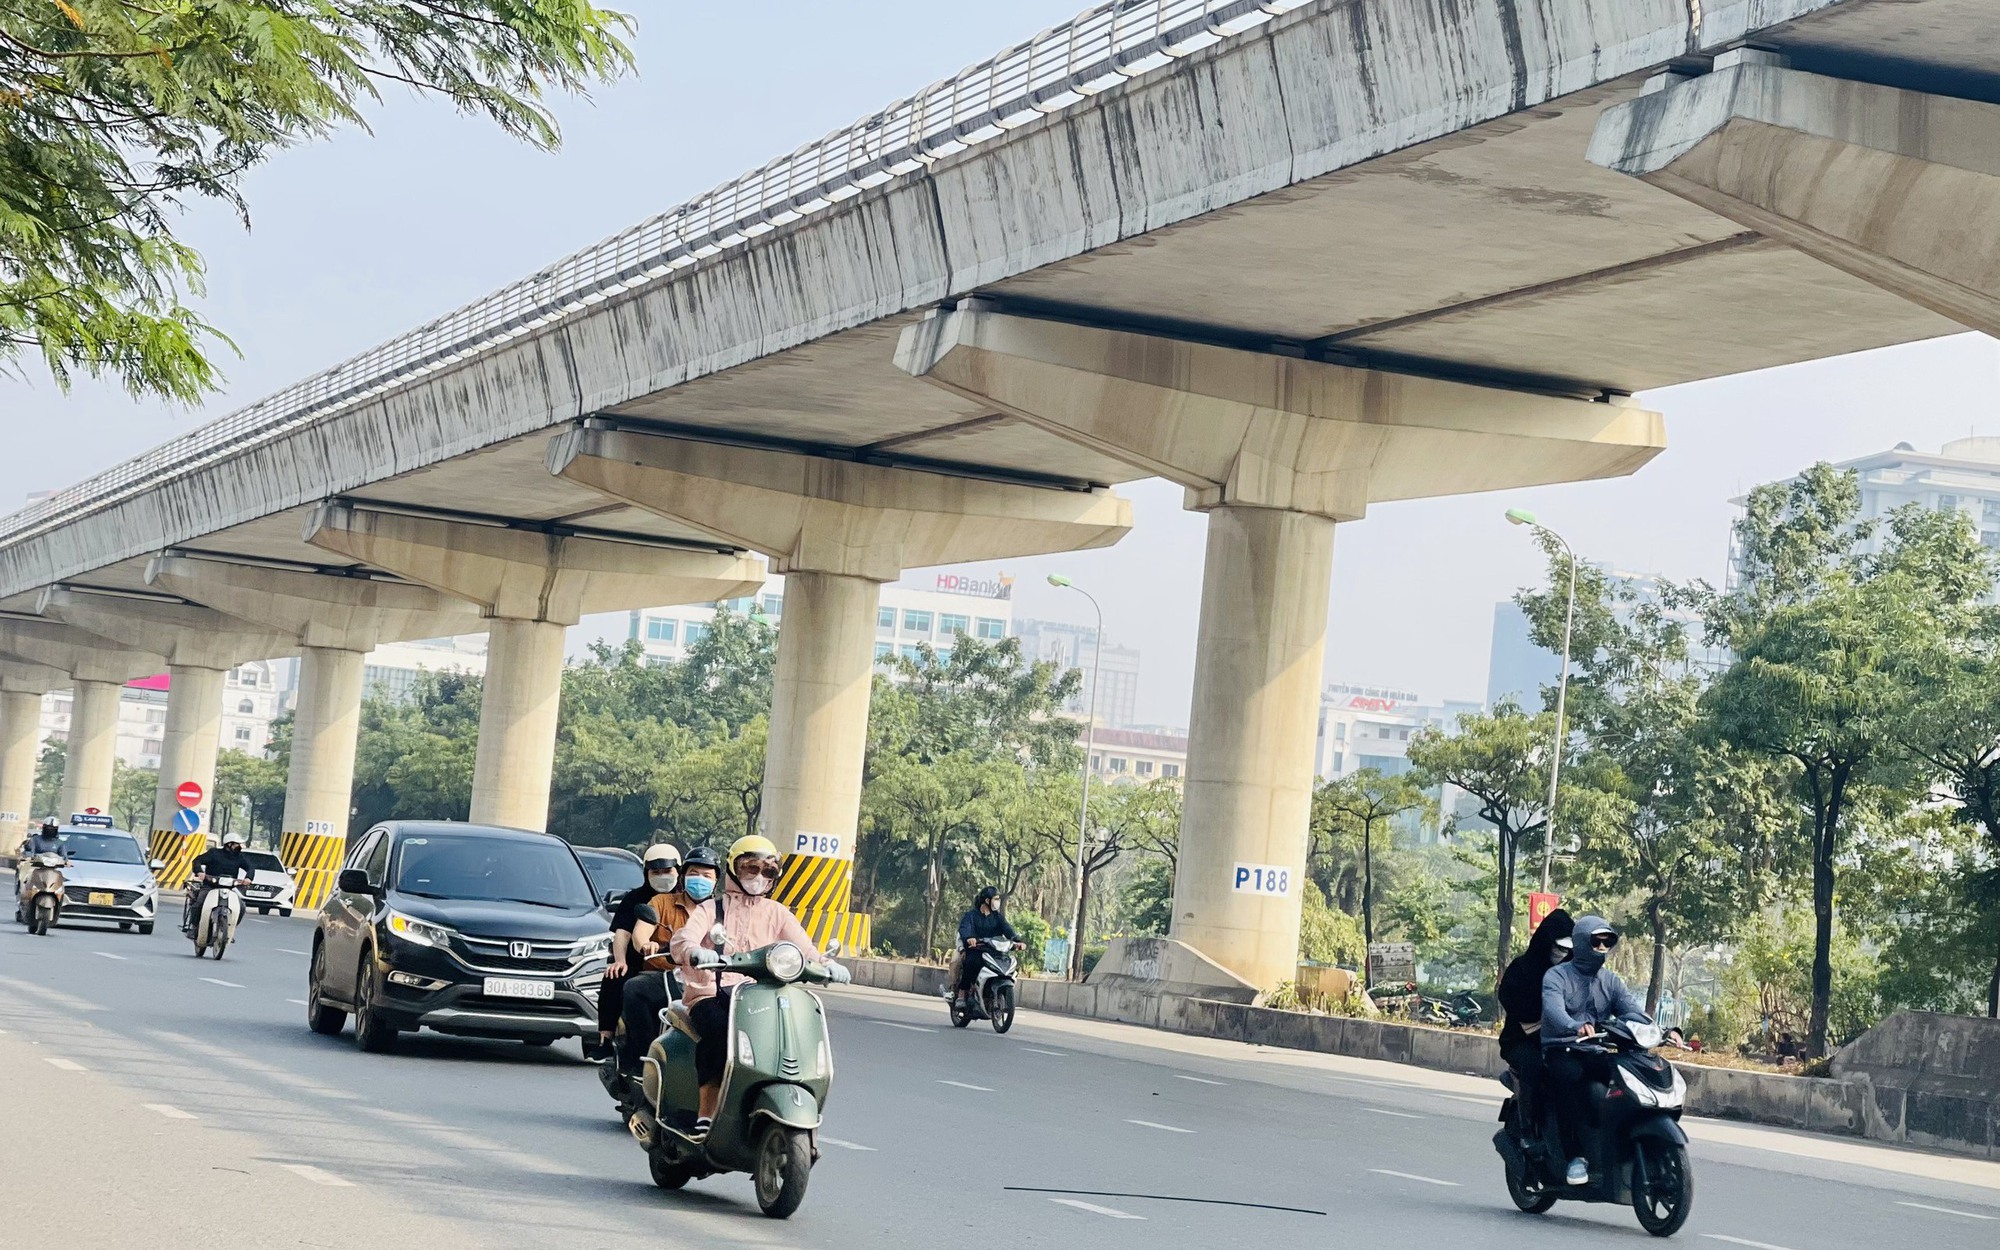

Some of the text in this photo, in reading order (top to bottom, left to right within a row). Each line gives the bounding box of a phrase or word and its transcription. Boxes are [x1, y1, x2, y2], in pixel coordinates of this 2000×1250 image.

[937, 574, 999, 593] HDBank
[307, 821, 335, 835] P191
[797, 834, 839, 854] P189
[1235, 867, 1288, 893] P188
